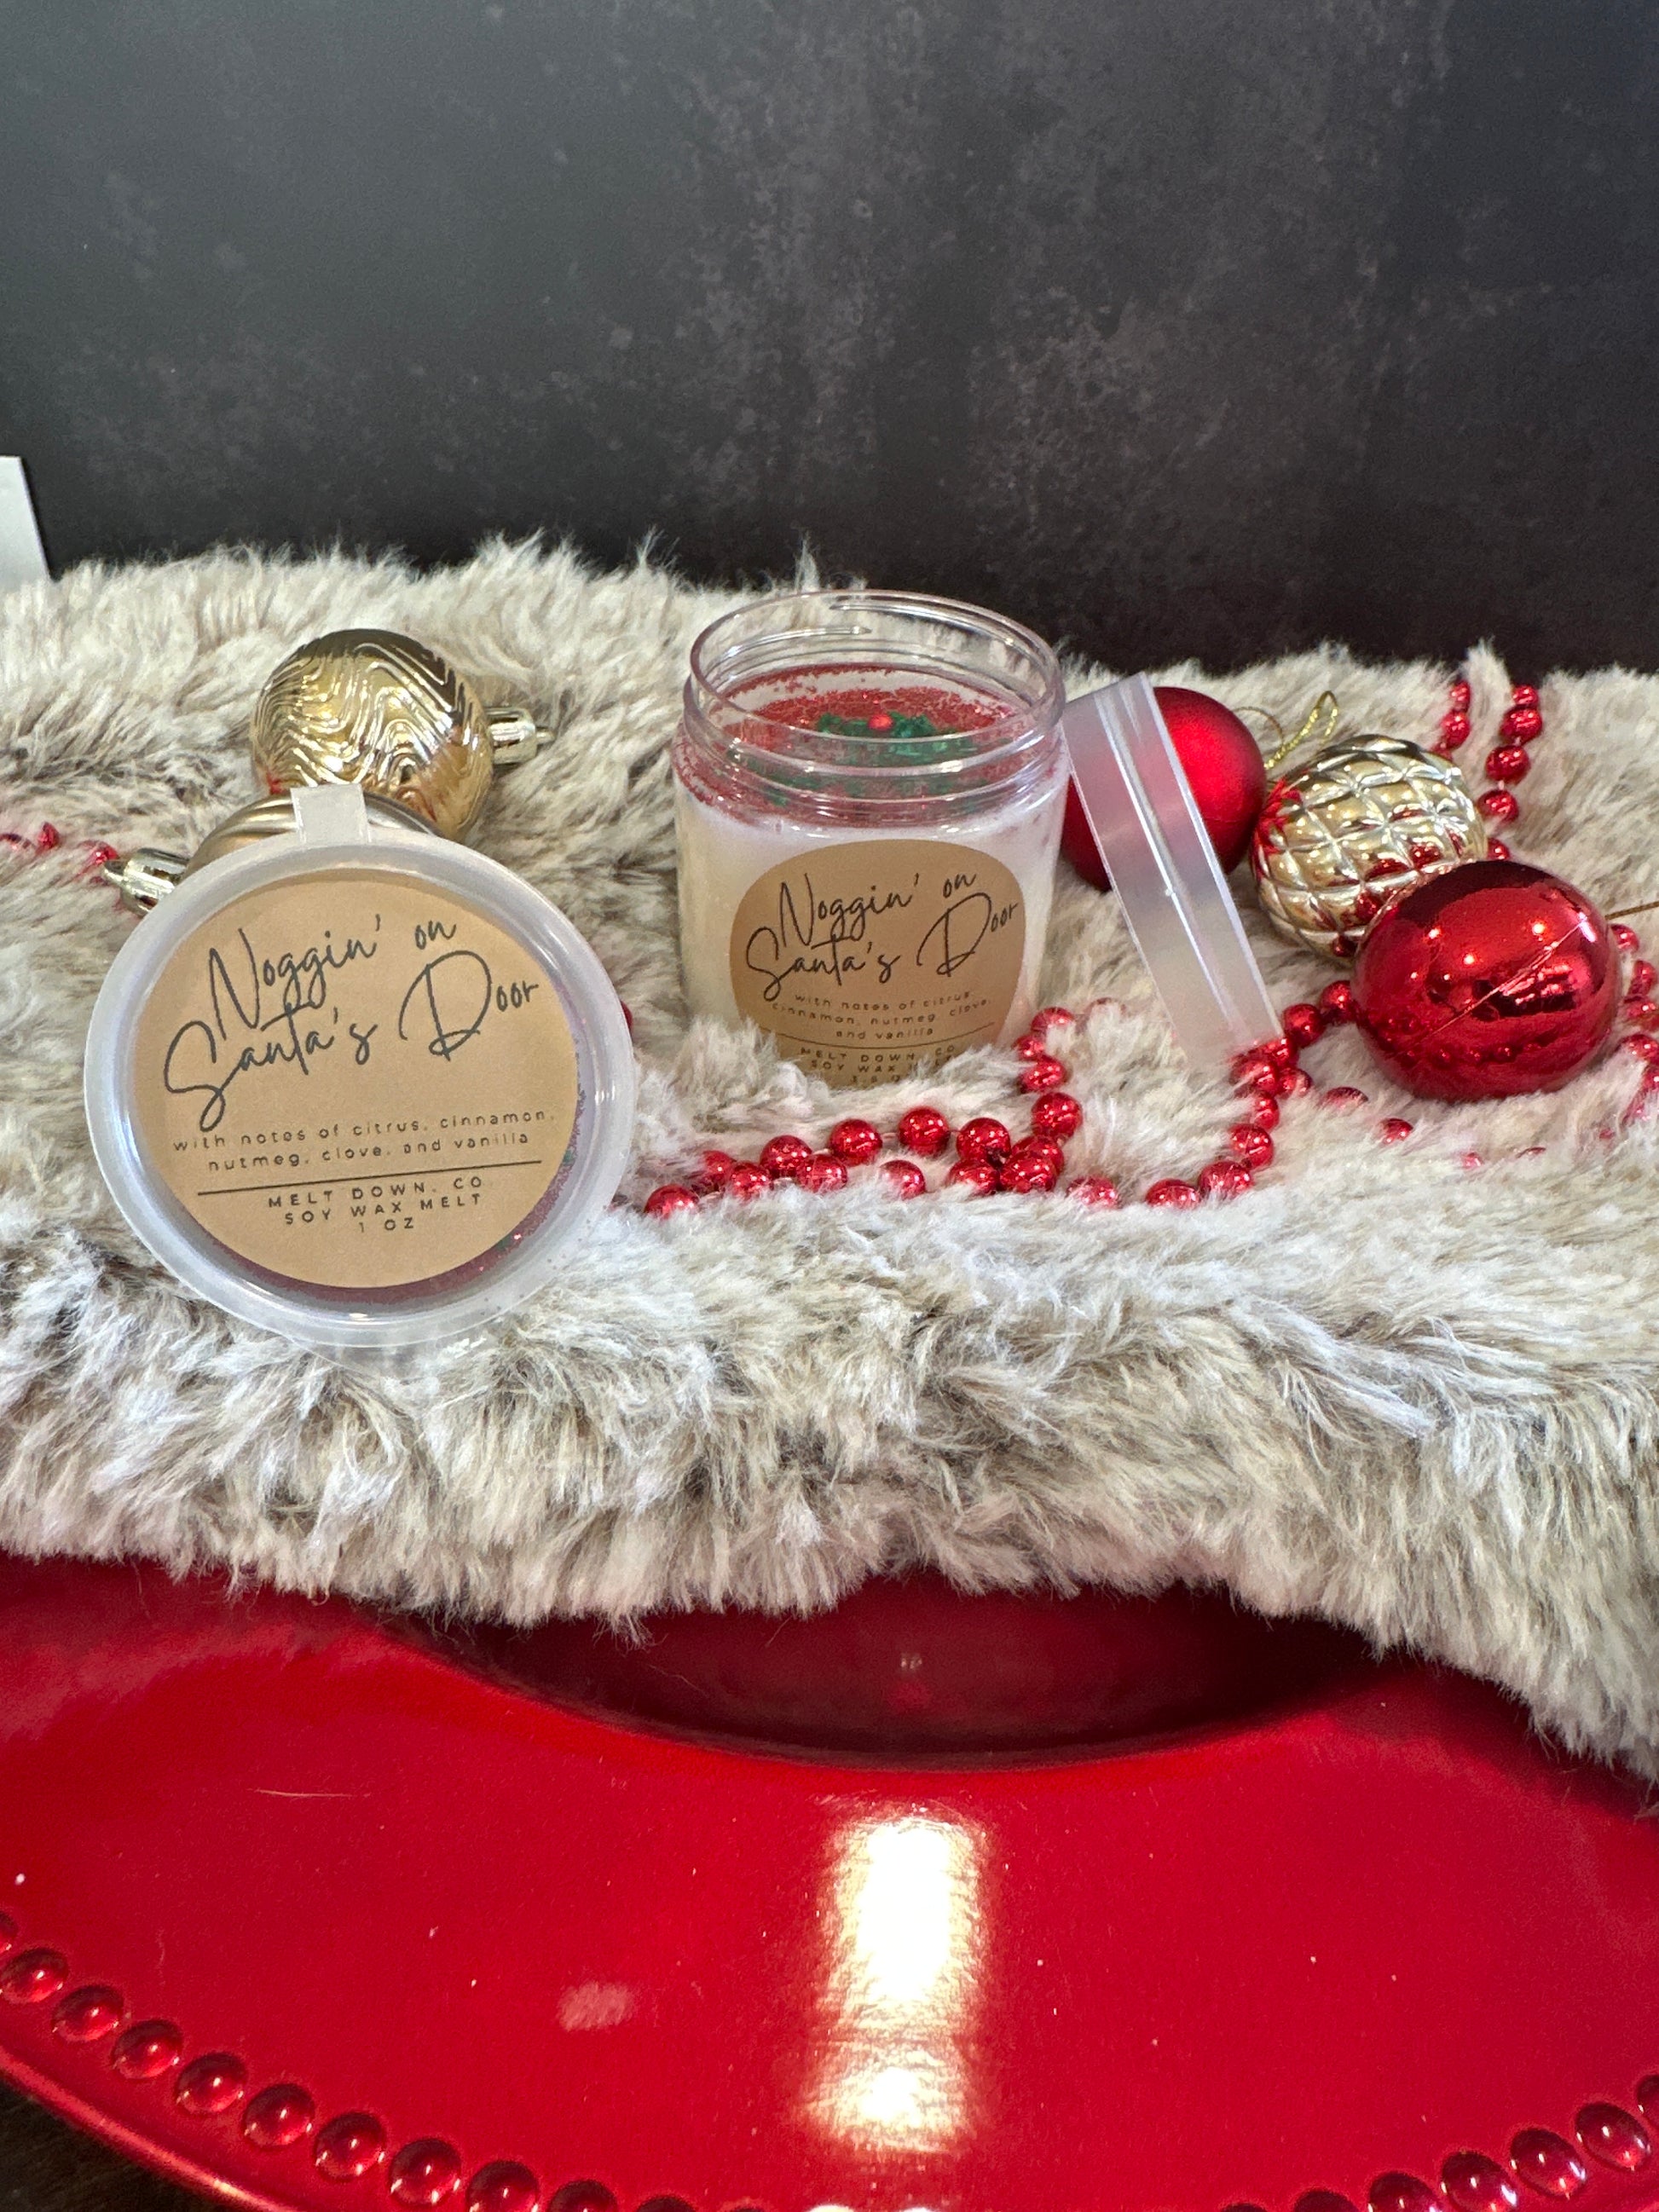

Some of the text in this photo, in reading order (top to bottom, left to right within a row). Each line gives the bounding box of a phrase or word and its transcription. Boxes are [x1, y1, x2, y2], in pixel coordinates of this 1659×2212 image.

[779, 872, 978, 948] Noggin' on
[746, 892, 1018, 1002] Santa's Door
[209, 913, 458, 1042] Noggin' on
[795, 994, 831, 1008] with
[841, 1001, 889, 1011] notes
[899, 999, 916, 1009] of
[163, 950, 540, 1132] Santa's Door
[835, 1026, 934, 1040] and vanilla
[800, 1047, 848, 1060] MELT
[934, 1044, 956, 1056] CO
[811, 1060, 846, 1071] SOY
[857, 1065, 897, 1073] WAX
[173, 1135, 226, 1152] with
[241, 1129, 306, 1145] notes
[318, 1123, 338, 1138] of
[403, 1138, 442, 1154] and
[454, 1132, 529, 1150] vanilla
[269, 1190, 333, 1208] MELT
[454, 1175, 483, 1190] CO
[285, 1193, 481, 1225] SOY WAX MELT
[358, 1216, 414, 1233] 1 OZ
